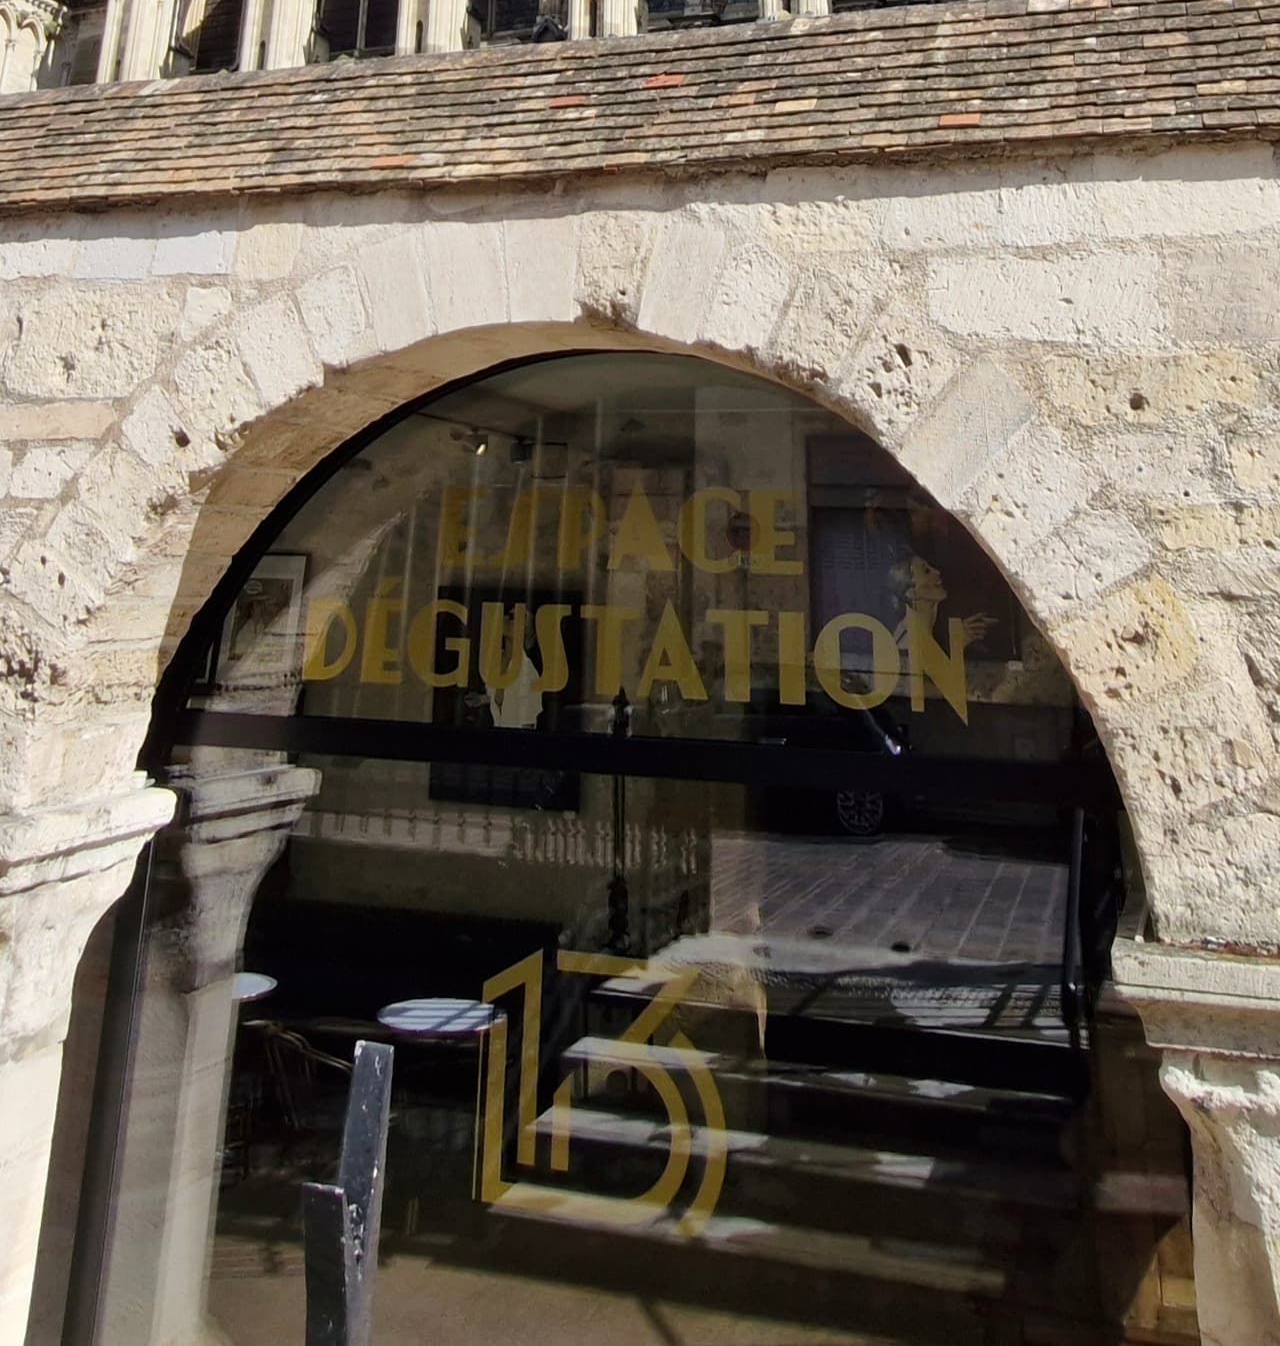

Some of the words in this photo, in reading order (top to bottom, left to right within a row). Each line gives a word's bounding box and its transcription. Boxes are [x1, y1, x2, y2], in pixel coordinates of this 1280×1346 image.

[438, 474, 804, 576] ESPACE
[303, 579, 968, 725] DÉGUSTATION
[481, 948, 727, 1238] 13
